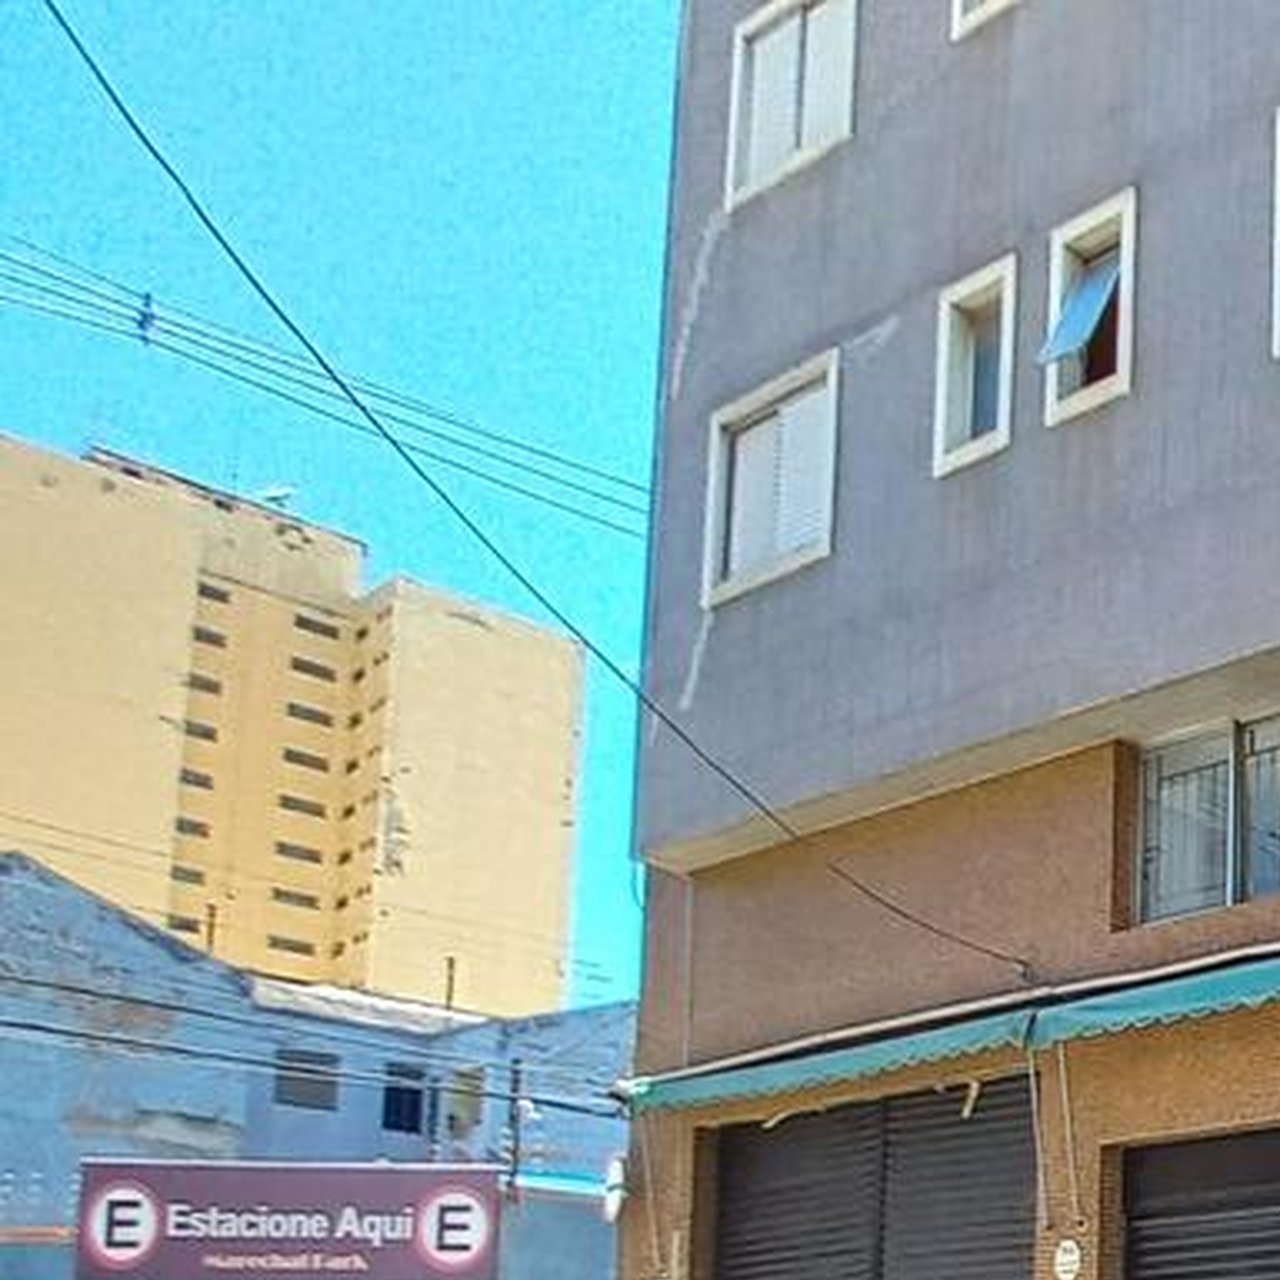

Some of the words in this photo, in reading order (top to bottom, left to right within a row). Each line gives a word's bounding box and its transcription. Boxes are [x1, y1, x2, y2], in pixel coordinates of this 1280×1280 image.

[104, 1200, 142, 1248] E
[166, 1205, 330, 1239] Estacione
[334, 1206, 414, 1245] Aqui
[435, 1204, 473, 1252] E
